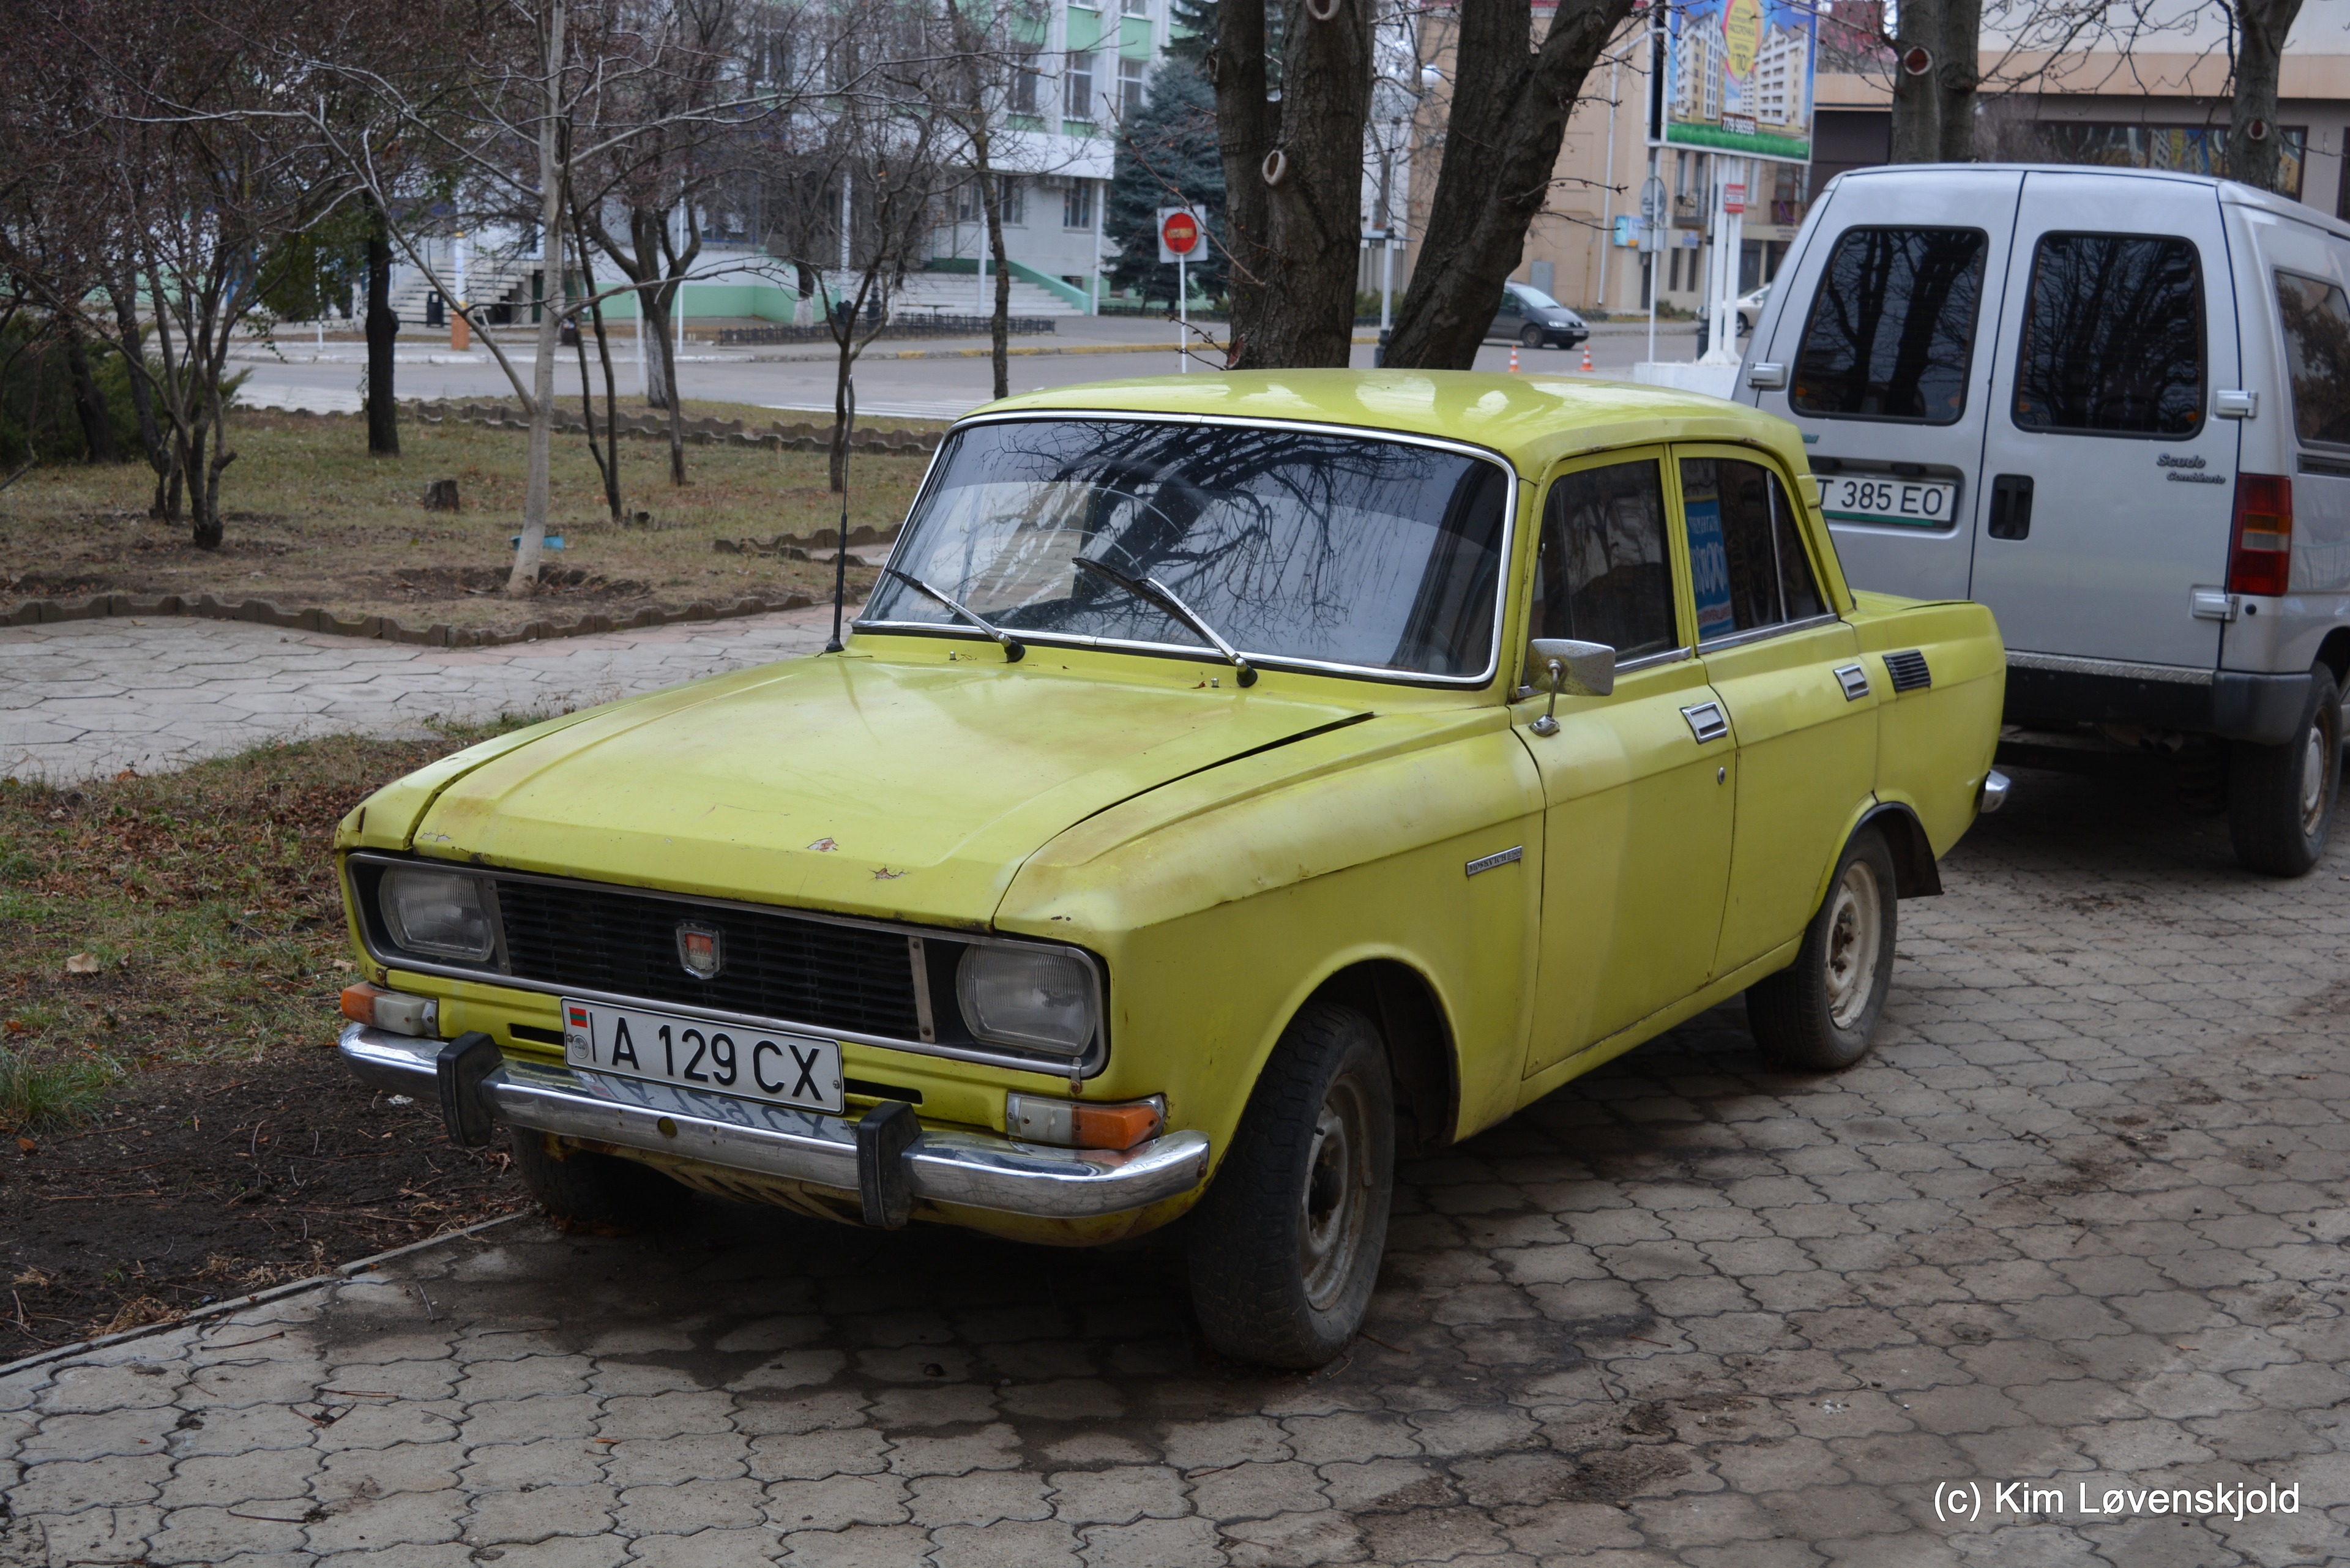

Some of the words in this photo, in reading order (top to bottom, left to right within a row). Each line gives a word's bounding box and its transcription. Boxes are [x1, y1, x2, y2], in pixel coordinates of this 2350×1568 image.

[2157, 452, 2206, 468] Scudo
[1816, 479, 1834, 506] T
[1841, 480, 1892, 511] 385
[1900, 486, 1942, 515] EO
[1469, 854, 1507, 873] MOSKVICH
[611, 1017, 640, 1070] A
[658, 1024, 737, 1086] 129
[752, 1039, 824, 1101] CX
